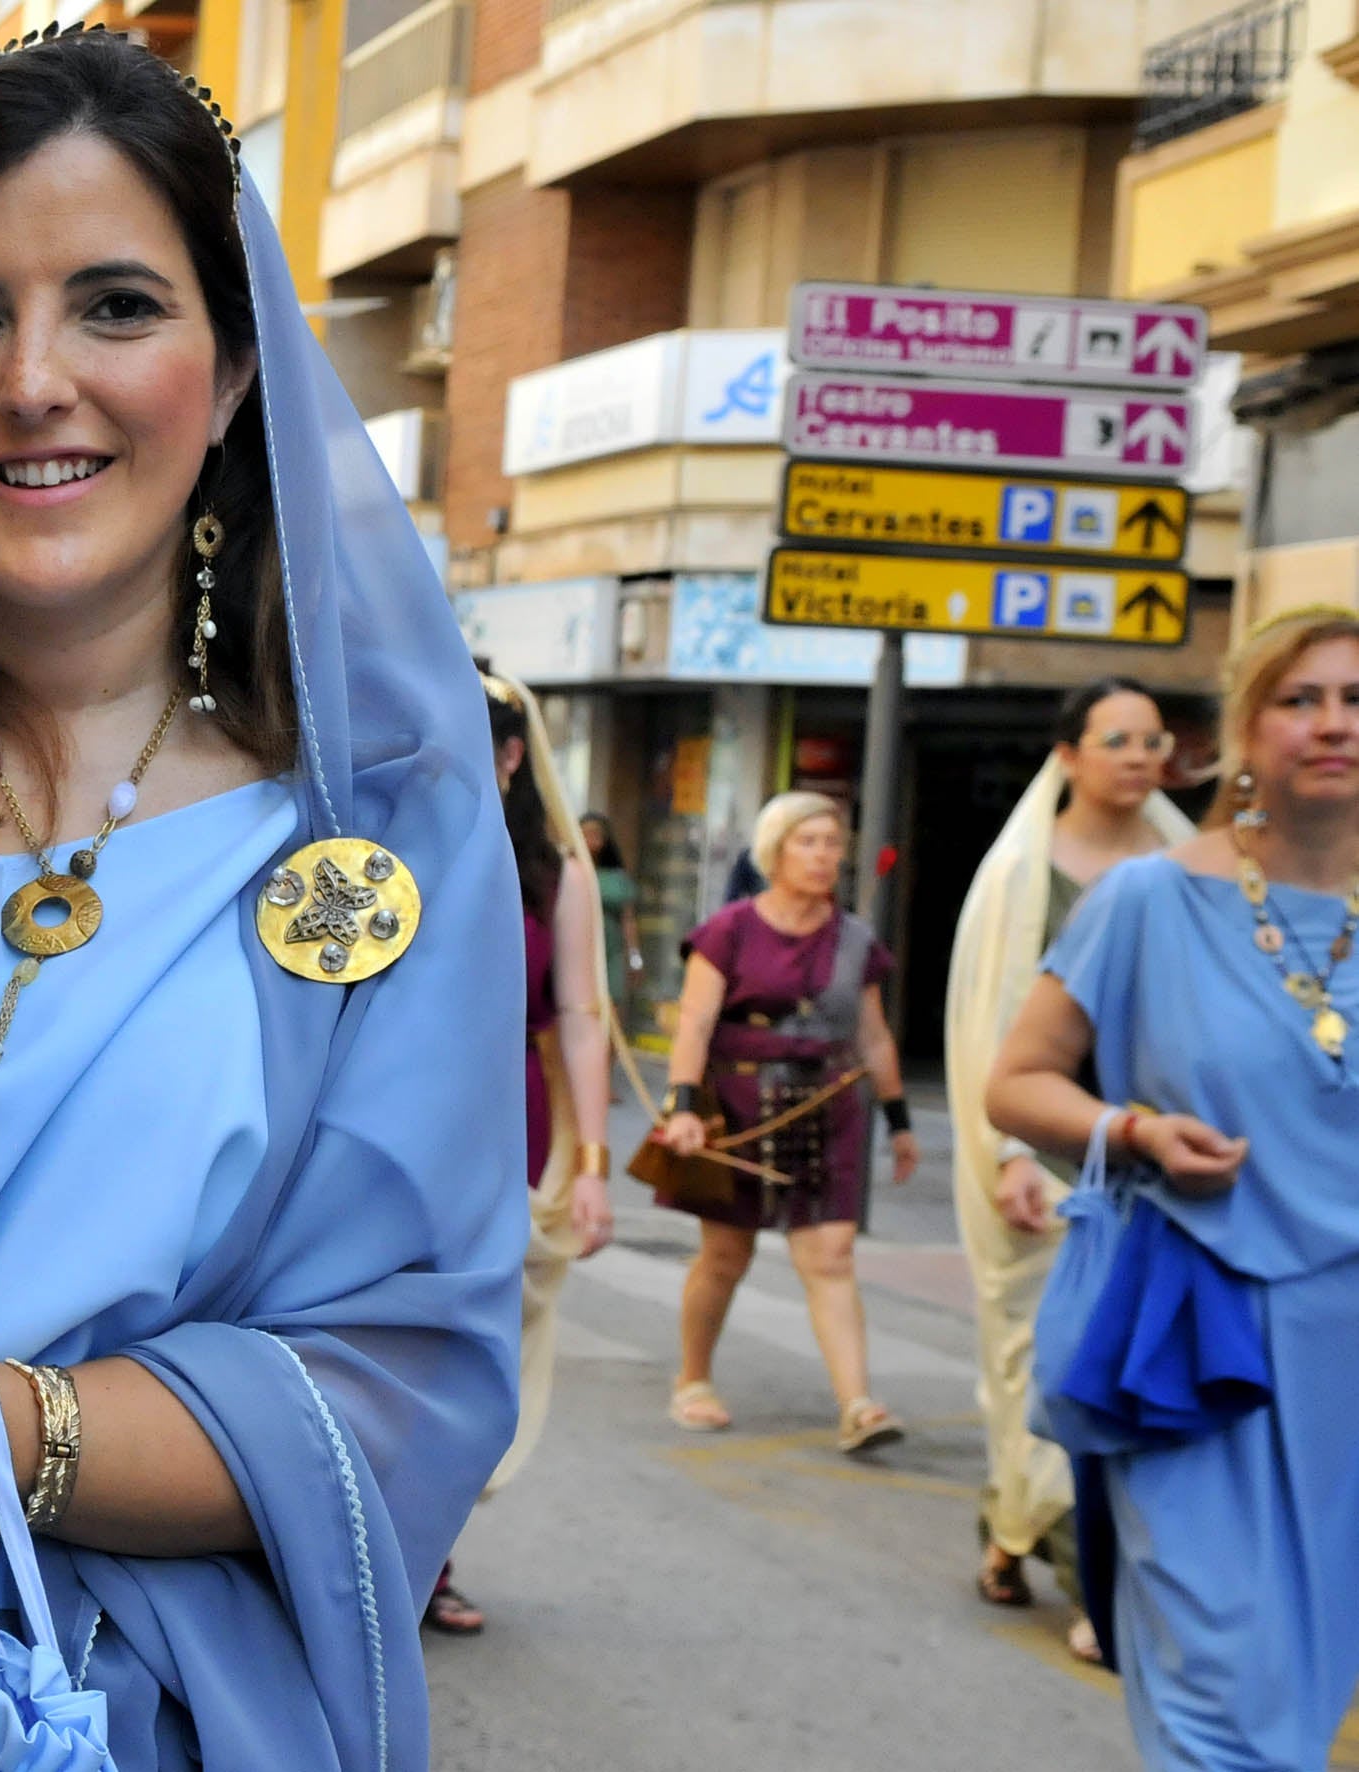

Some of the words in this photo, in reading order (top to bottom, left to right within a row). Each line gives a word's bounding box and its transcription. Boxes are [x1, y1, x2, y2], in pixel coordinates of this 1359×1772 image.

[871, 298, 1001, 340] Posito
[799, 383, 913, 418] Teatro
[799, 415, 998, 454] Cervantes
[796, 473, 873, 495] Hotel
[796, 499, 985, 541] Cervantes
[780, 560, 859, 581] Hotel
[781, 587, 929, 623] Victoria
